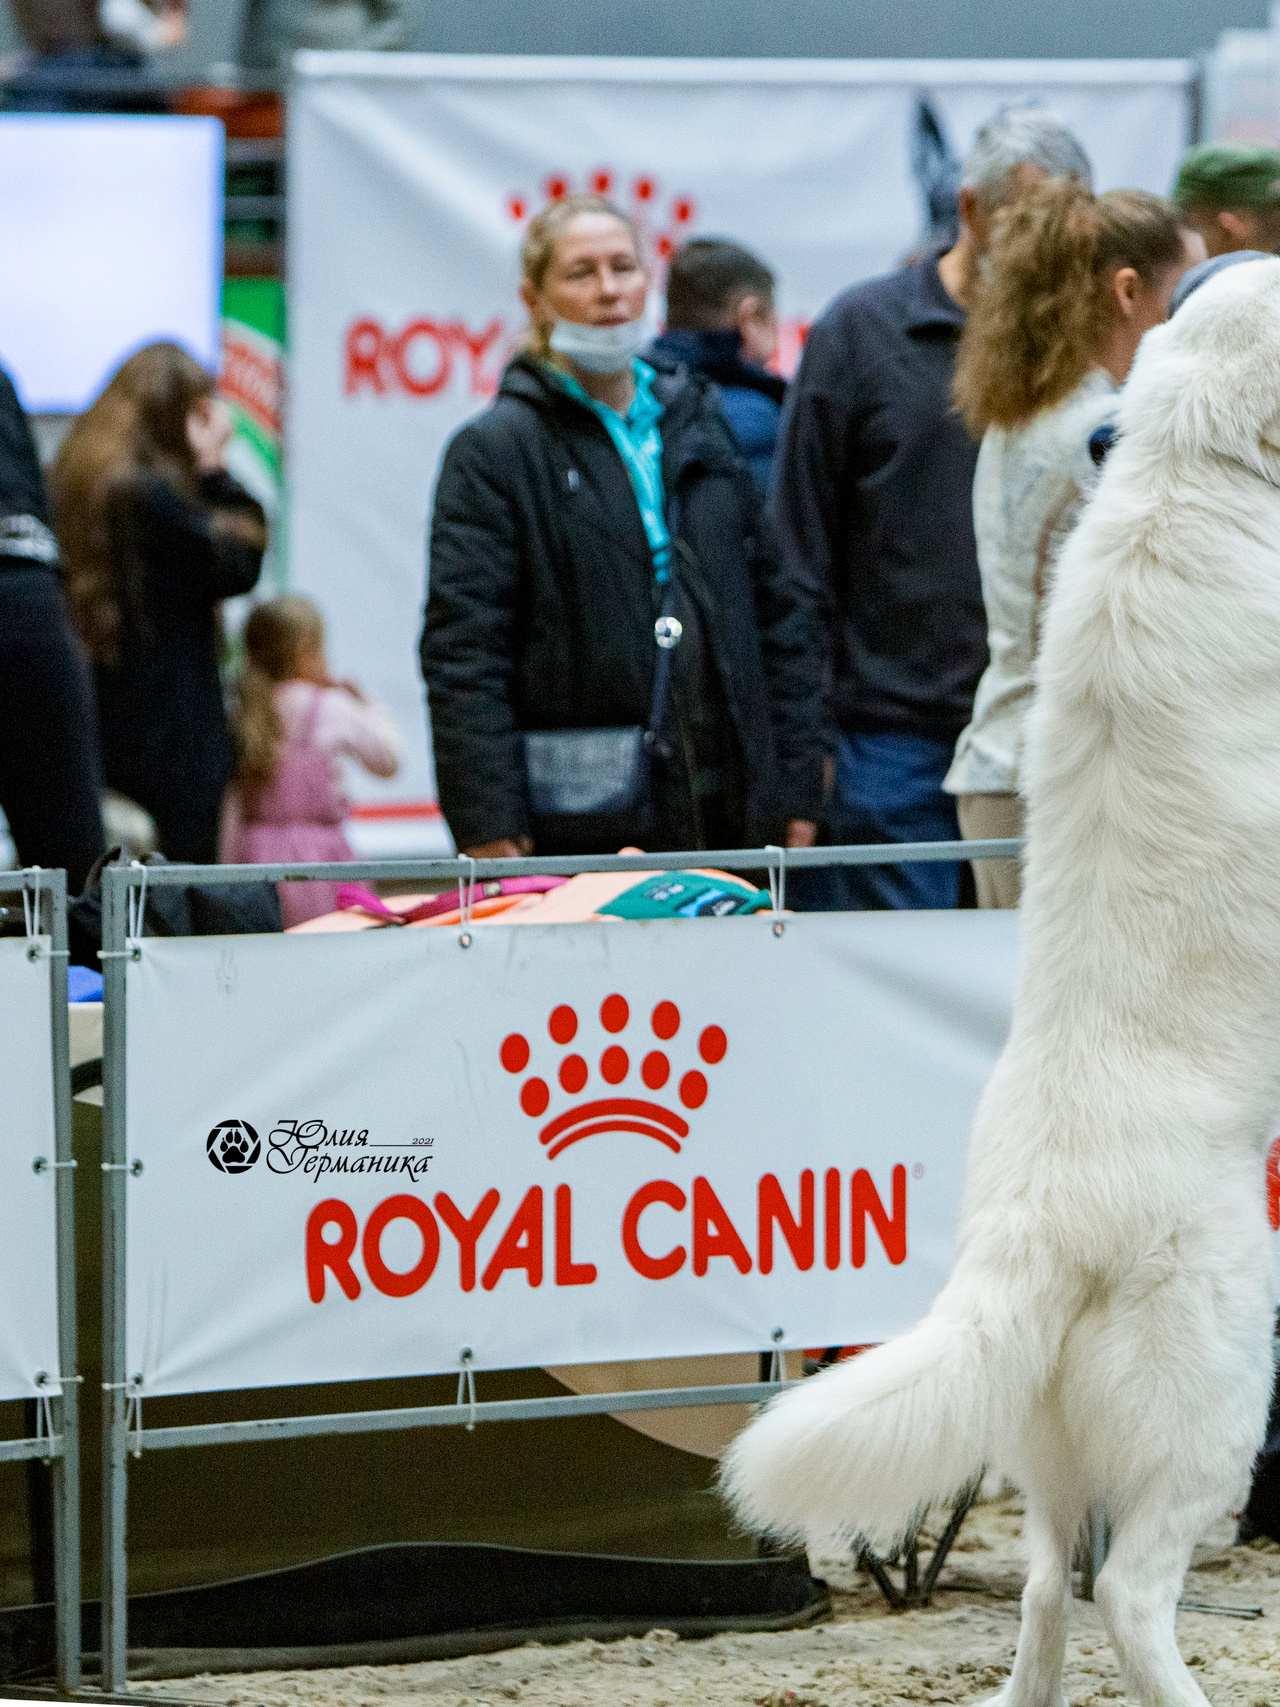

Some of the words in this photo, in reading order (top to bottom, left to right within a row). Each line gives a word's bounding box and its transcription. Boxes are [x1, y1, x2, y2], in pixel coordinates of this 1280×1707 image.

[344, 314, 507, 402] ROY
[305, 1183, 598, 1304] ROYAL
[621, 1163, 907, 1281] CANIN
